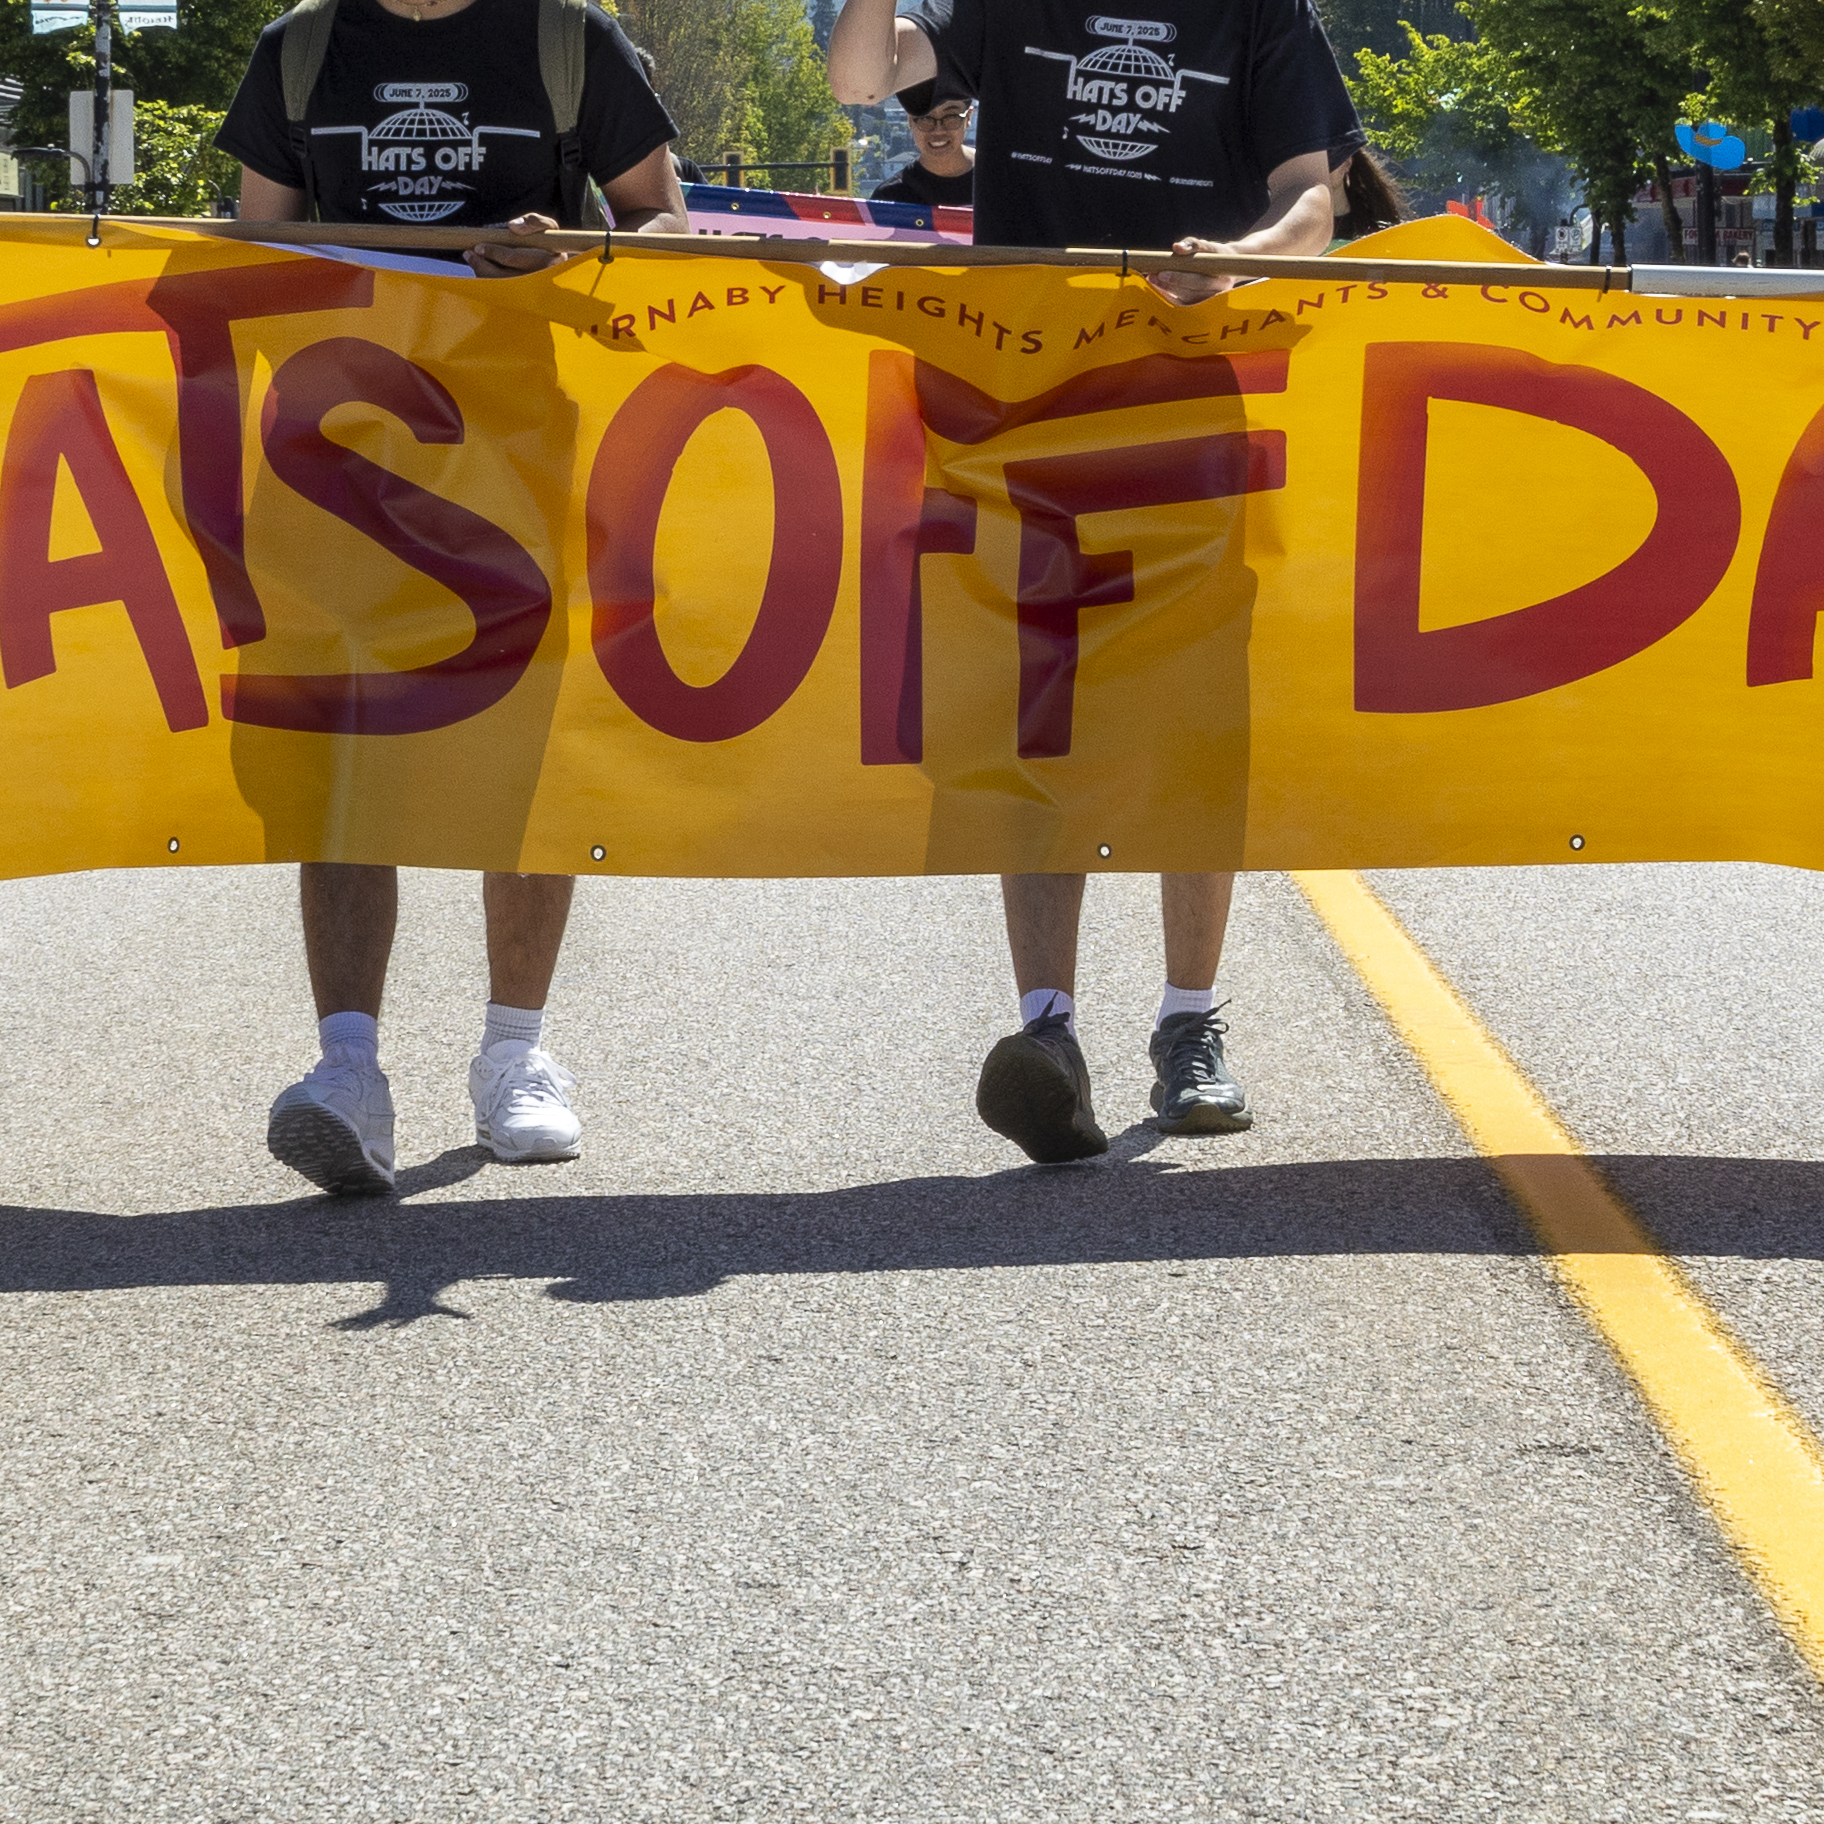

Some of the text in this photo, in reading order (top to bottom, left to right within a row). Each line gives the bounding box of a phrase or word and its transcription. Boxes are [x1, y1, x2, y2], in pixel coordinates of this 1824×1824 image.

[1100, 22, 1125, 34] JUNE
[1137, 25, 1161, 37] 2025
[389, 88, 413, 98] JUNE
[427, 88, 452, 98] 2025
[1067, 76, 1187, 113] HATS OFF
[1095, 109, 1142, 135] DAY
[362, 147, 487, 171] HATS OFF
[396, 176, 443, 196] DAY
[591, 283, 786, 341] RNABY
[817, 283, 1044, 355] HEIGHTS
[1072, 280, 1390, 351] MERCHANTS
[1421, 281, 1451, 299] &
[1480, 283, 1822, 341] COMMUNITY
[585, 350, 1289, 766] OFF
